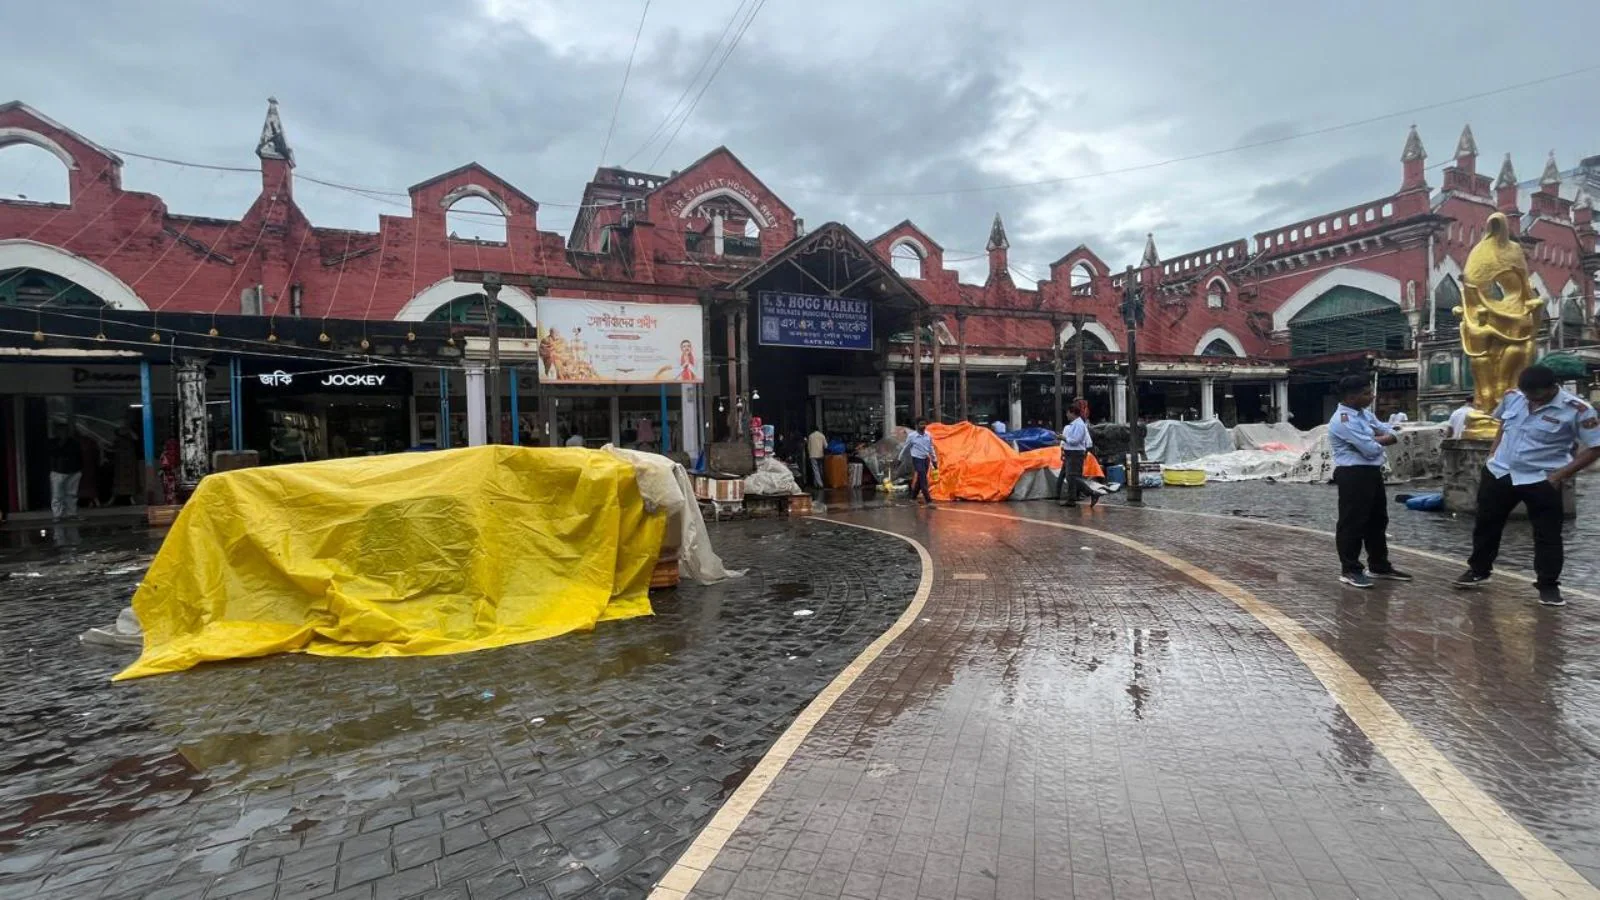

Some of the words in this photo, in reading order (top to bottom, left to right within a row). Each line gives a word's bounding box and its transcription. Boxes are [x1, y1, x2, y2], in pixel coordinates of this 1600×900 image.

[670, 200, 685, 217] SIR
[683, 178, 724, 201] STUART
[751, 194, 779, 229] MRKET
[775, 296, 786, 308] S.
[788, 296, 821, 310] HOGG
[823, 299, 868, 314] MARKET
[258, 369, 293, 387] জকি
[320, 374, 386, 386] JOCKEY
